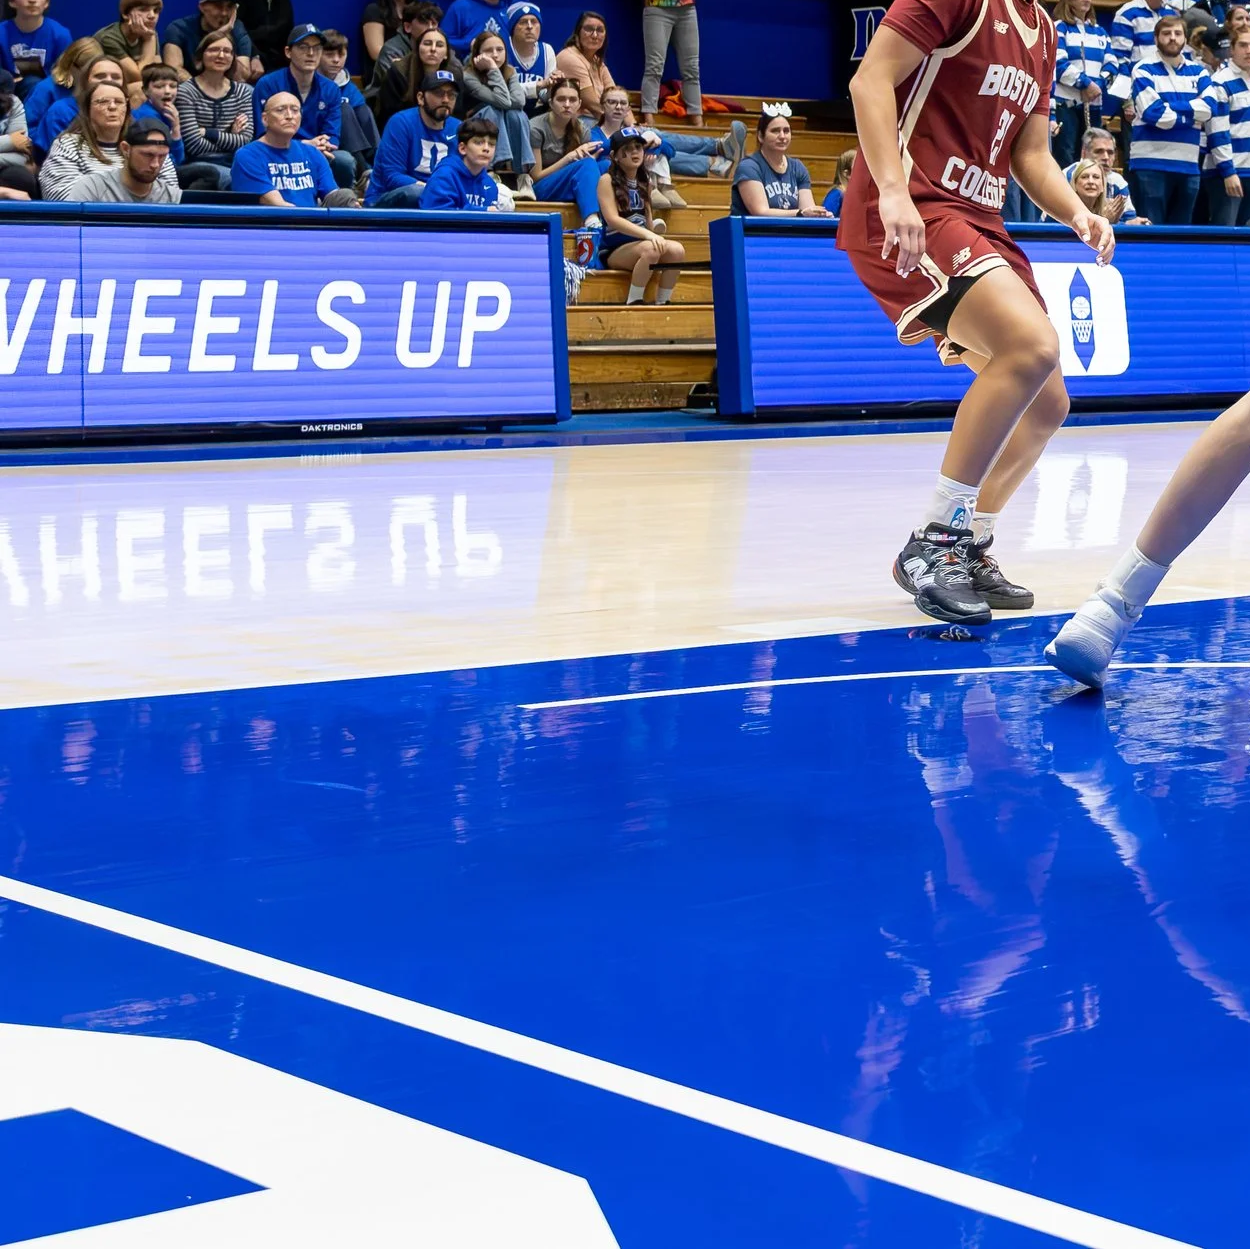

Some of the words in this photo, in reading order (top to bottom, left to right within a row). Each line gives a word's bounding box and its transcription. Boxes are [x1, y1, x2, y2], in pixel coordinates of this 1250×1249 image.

[978, 64, 1040, 117] BOSTON
[466, 193, 486, 207] UKE
[395, 280, 511, 369] UP
[301, 423, 363, 433] DAKTRONICS
